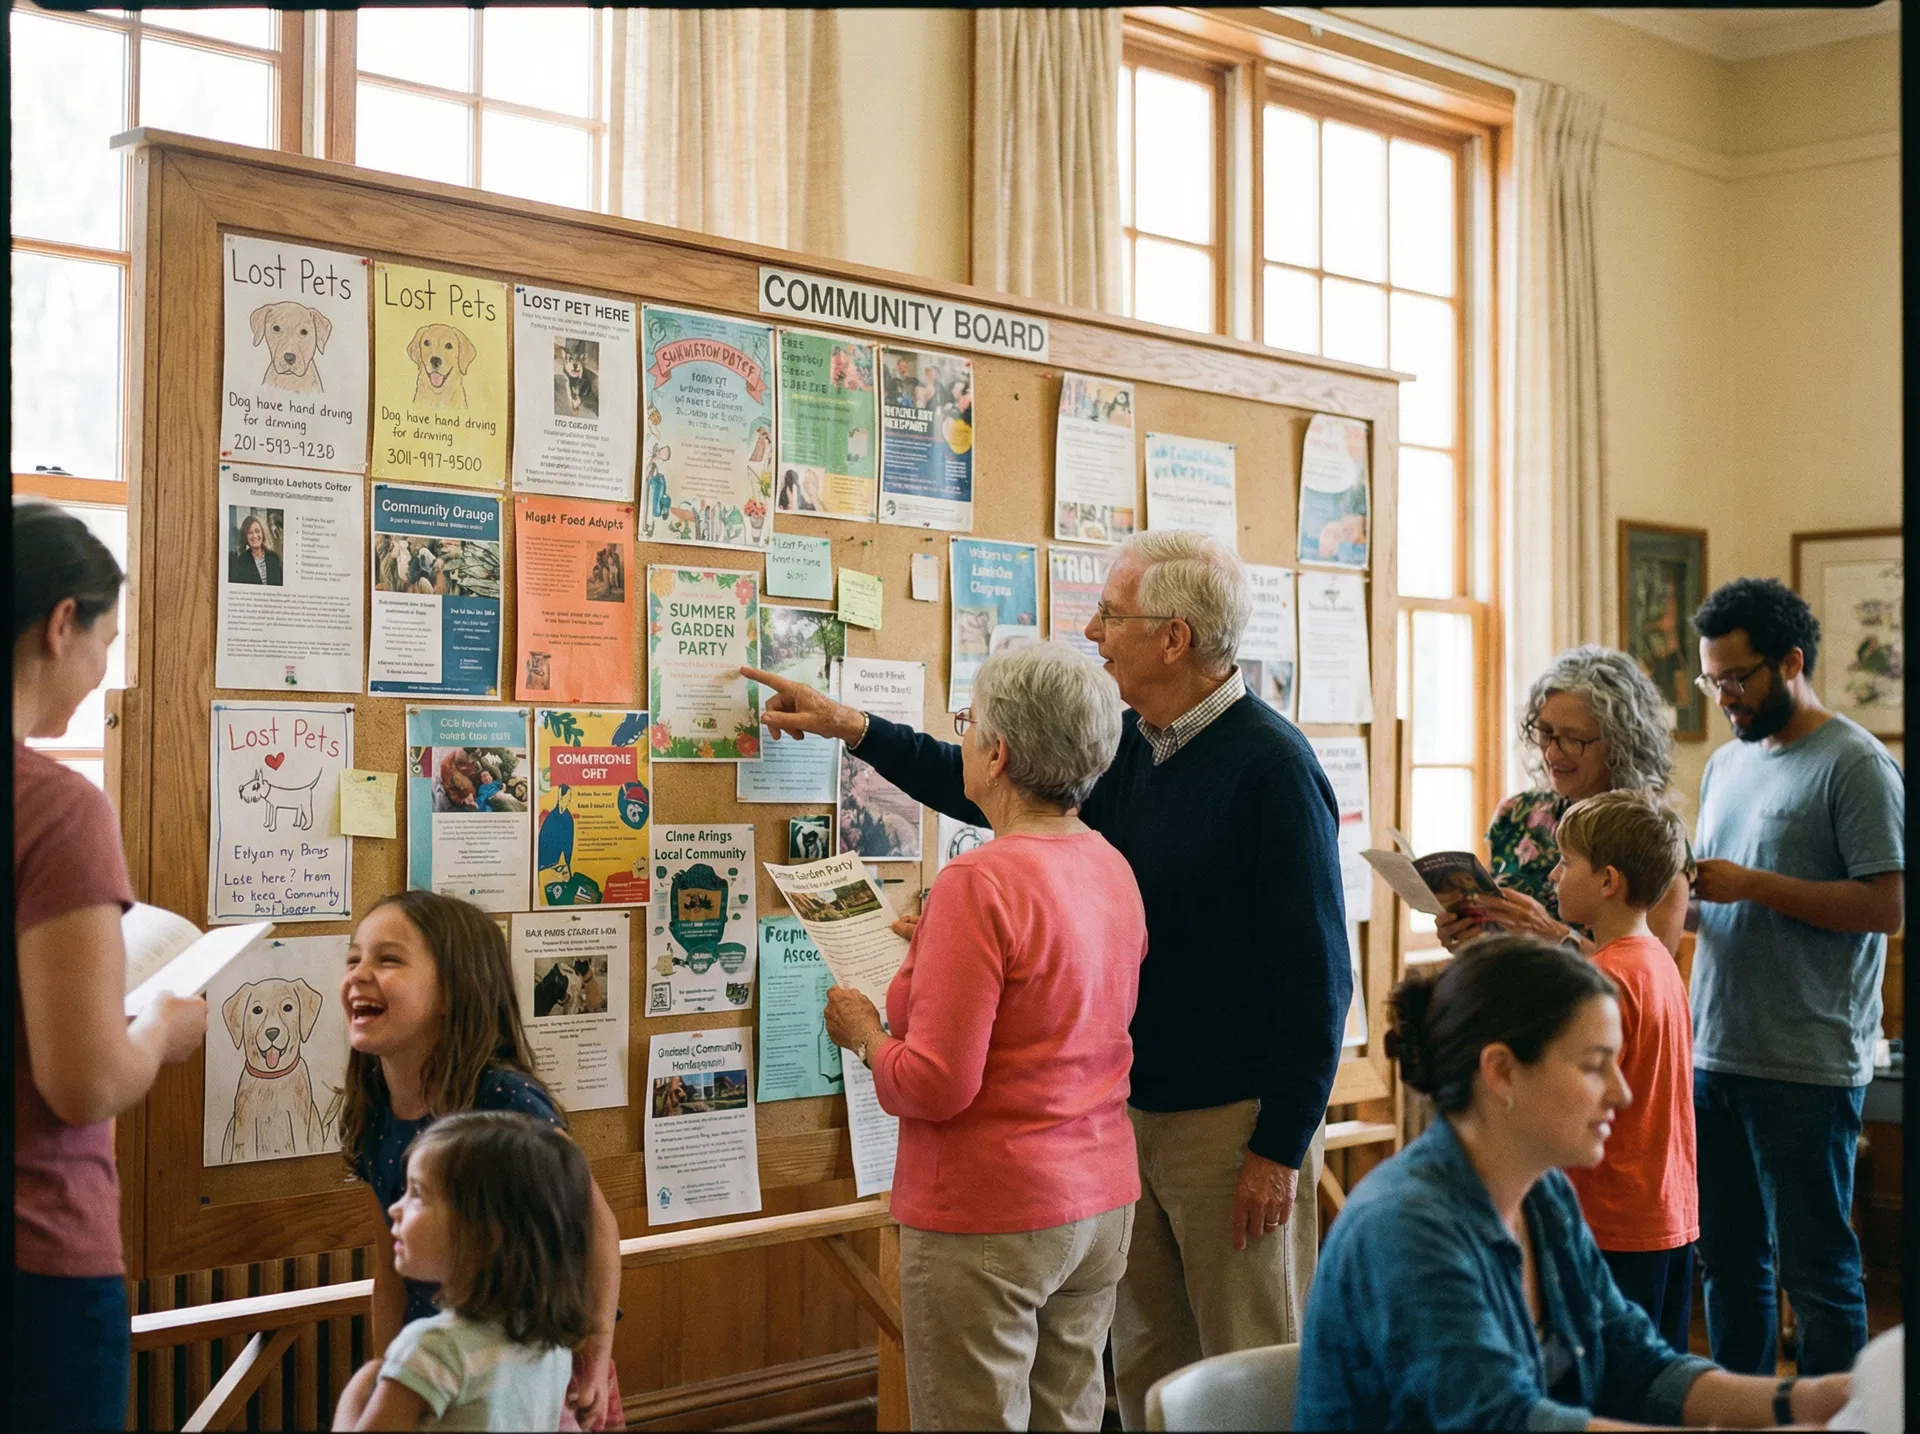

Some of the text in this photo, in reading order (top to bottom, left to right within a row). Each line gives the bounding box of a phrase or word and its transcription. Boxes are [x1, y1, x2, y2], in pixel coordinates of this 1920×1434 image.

[231, 248, 352, 300] Lost Pets
[384, 272, 496, 321] Lost Pets
[523, 292, 630, 323] LOST PET HERE
[764, 274, 1045, 352] COMMUNITY BOARD
[229, 391, 251, 413] Dog
[256, 396, 283, 412] have
[289, 400, 315, 415] hand
[243, 413, 259, 425] for
[381, 405, 401, 426] Dog
[406, 410, 430, 425] have
[435, 413, 460, 427] hand
[392, 426, 407, 438] for
[381, 499, 450, 520] Community
[669, 602, 736, 621] SUMMER
[671, 621, 735, 639] GARDEN
[678, 640, 728, 656] PARTY
[228, 716, 340, 758] Lost Pets
[654, 847, 747, 862] Local Community
[825, 860, 853, 876] Party
[231, 890, 245, 903] to
[284, 886, 340, 907] Community
